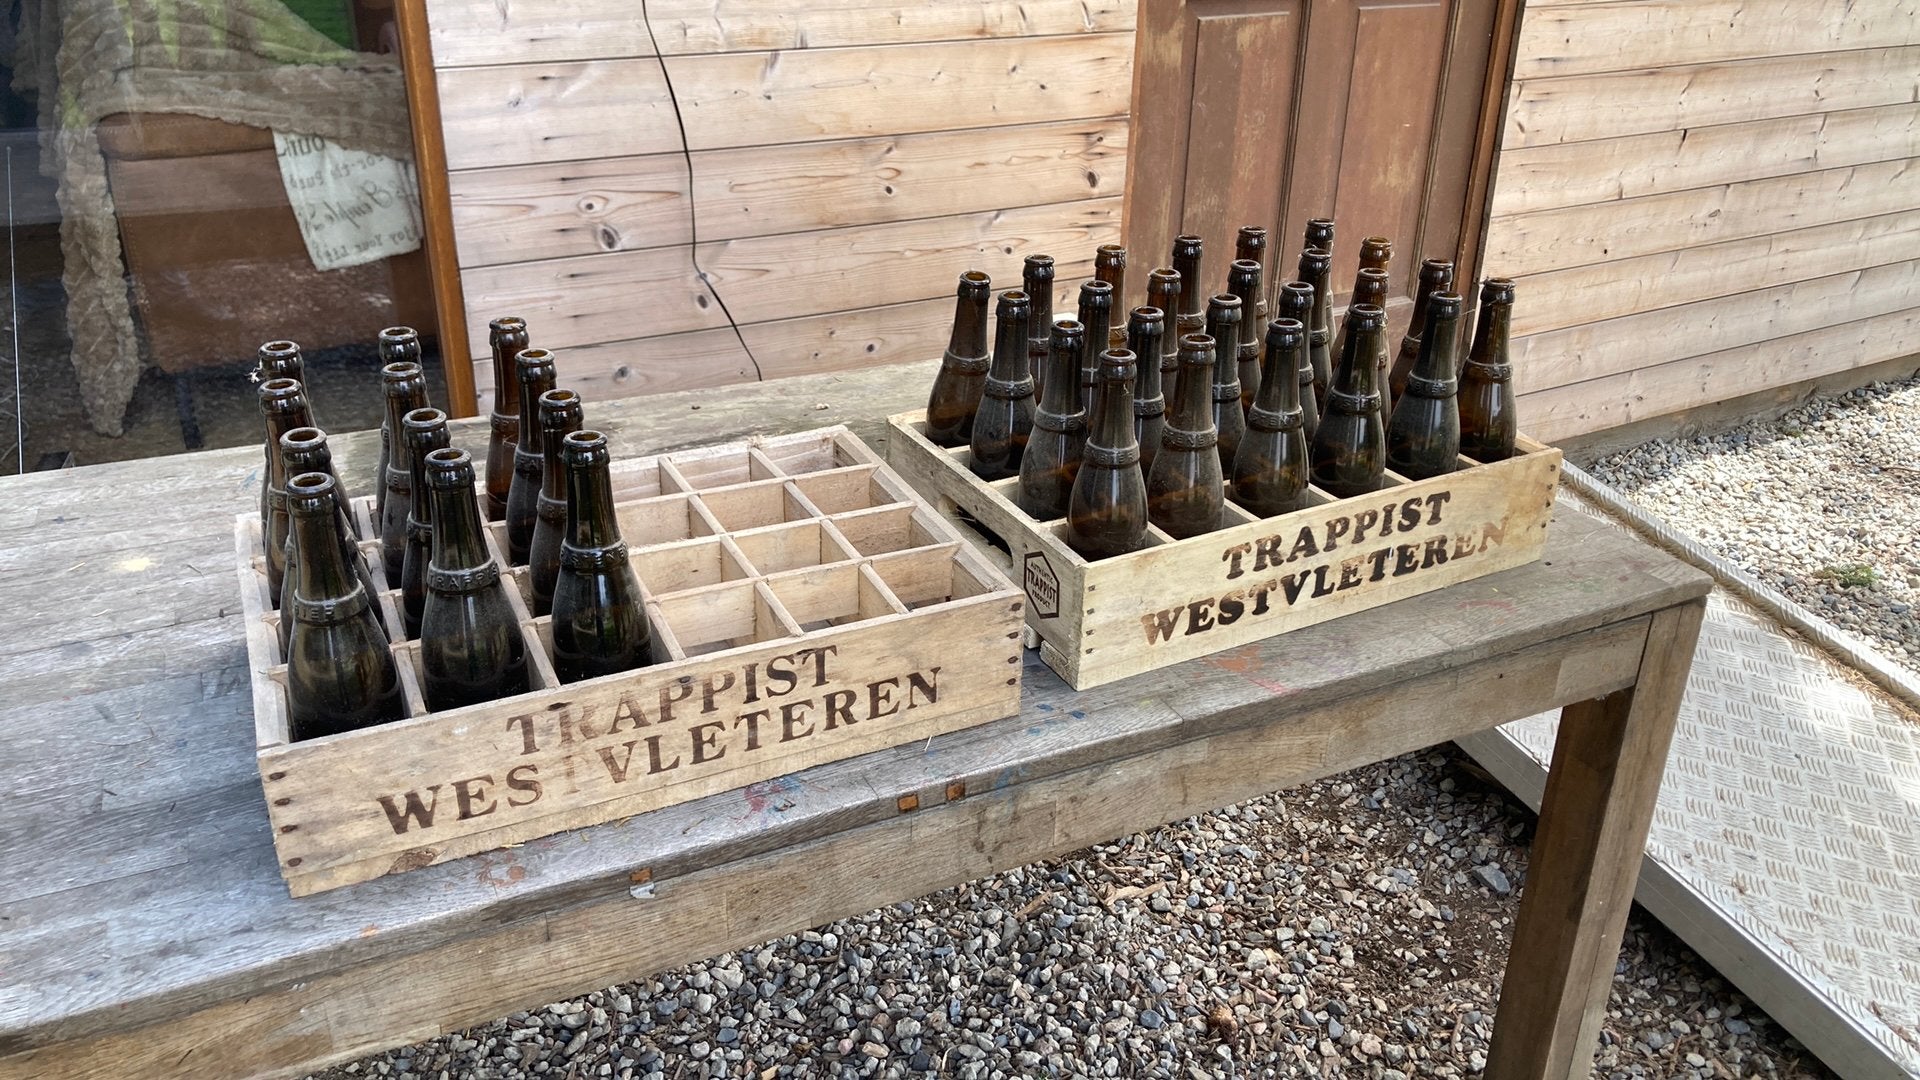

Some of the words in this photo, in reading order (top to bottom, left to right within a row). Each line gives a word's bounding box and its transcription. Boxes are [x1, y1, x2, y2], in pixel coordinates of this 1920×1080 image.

[1027, 567, 1057, 603] TRAPPIST
[1140, 517, 1511, 646] WESTVLETEREN
[1222, 490, 1451, 580] TRAPPIST
[506, 644, 839, 757] TRAPPIST
